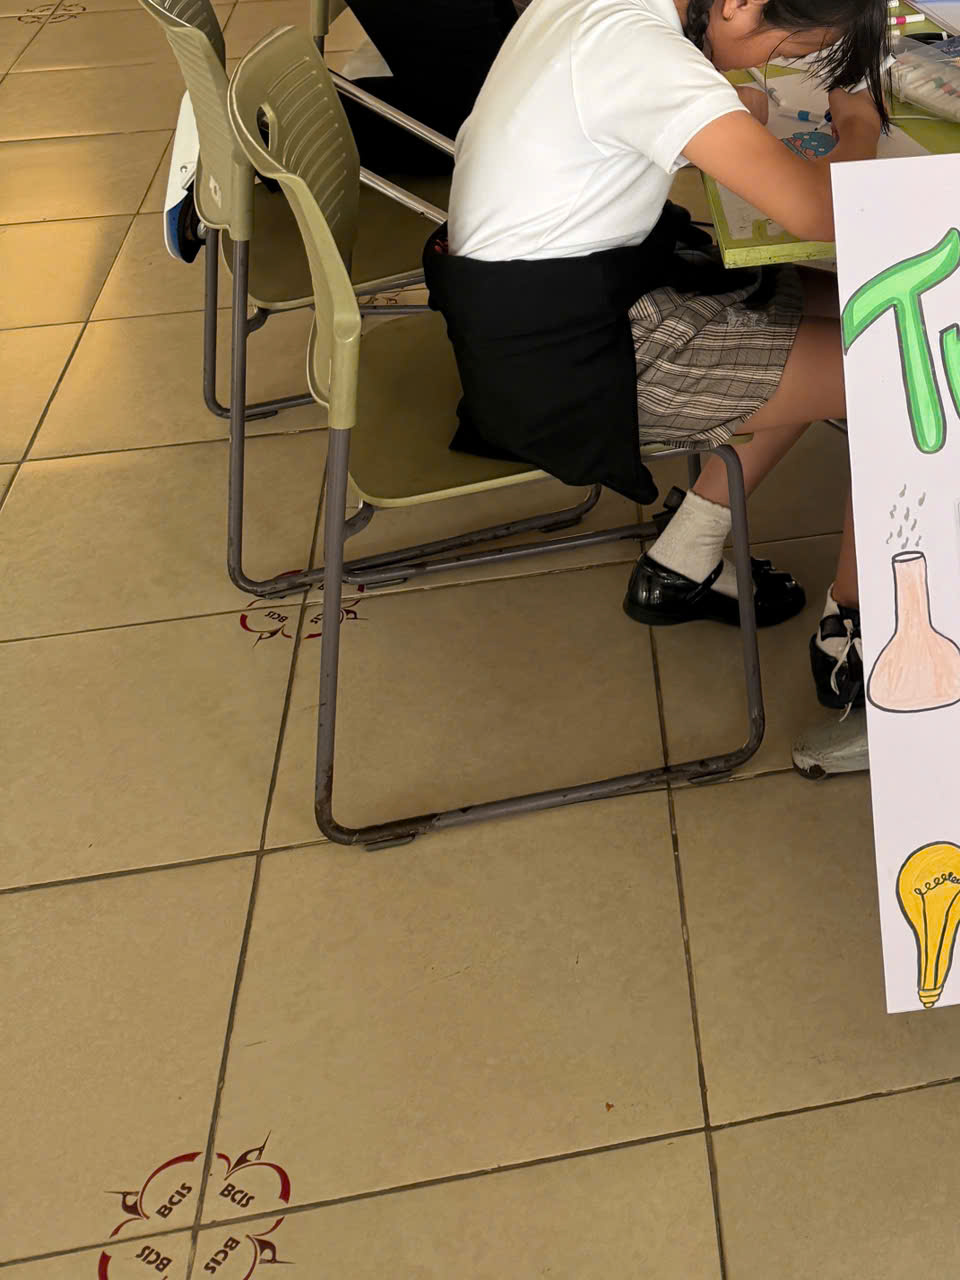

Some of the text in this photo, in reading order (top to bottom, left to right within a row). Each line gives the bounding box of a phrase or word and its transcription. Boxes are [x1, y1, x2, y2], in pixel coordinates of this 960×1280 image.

[156, 1182, 193, 1218] BCIS
[219, 1182, 255, 1209] BCIS
[135, 1245, 173, 1273] BCIS
[203, 1236, 241, 1274] BCIS
